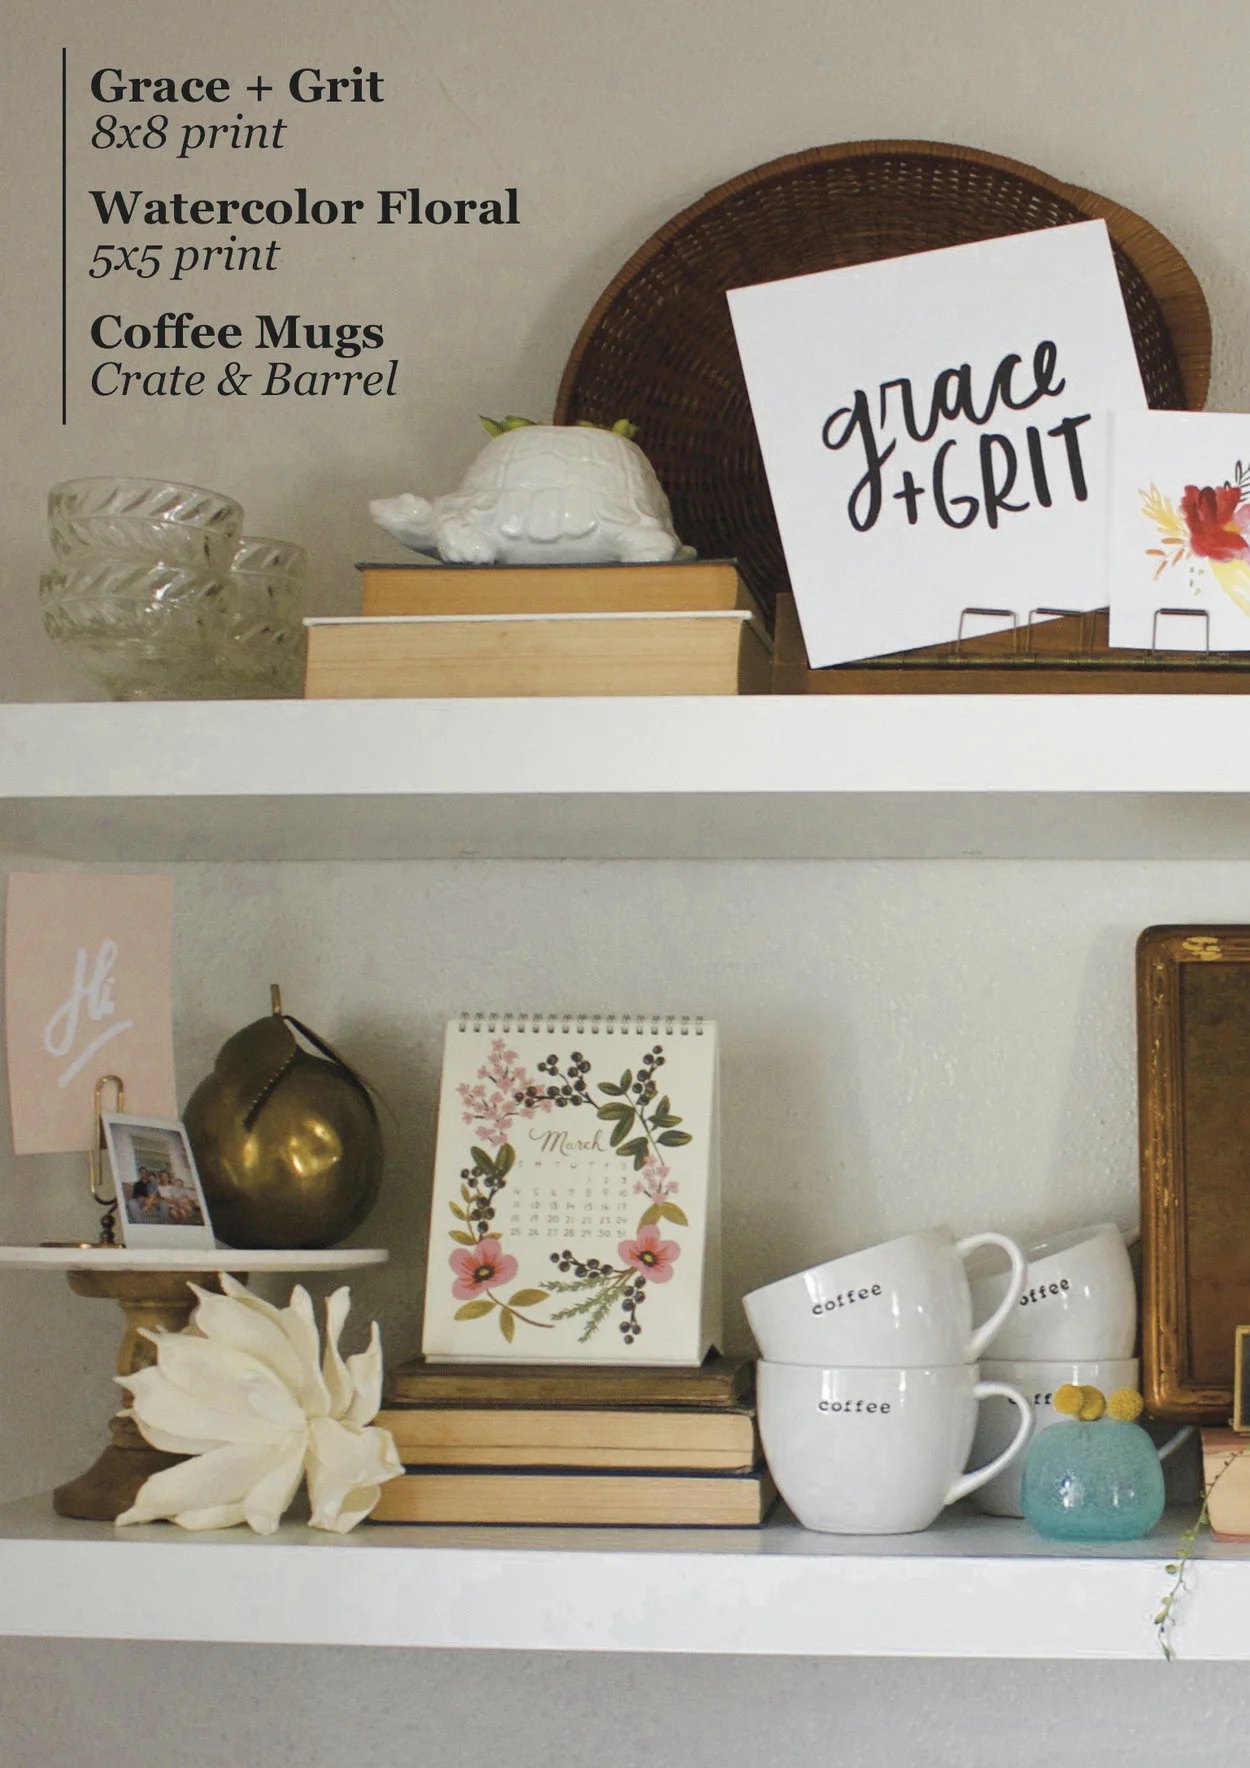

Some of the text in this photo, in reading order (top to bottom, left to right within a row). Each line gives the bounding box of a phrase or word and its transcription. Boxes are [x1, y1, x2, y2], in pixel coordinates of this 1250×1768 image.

[821, 340, 1066, 533] grace
[44, 939, 119, 1057] Hi
[528, 1127, 608, 1157] March
[510, 1228, 626, 1238] 25 26 27 28 29 30 31
[811, 1284, 882, 1315] coffee
[1019, 1279, 1070, 1306] offee
[818, 1400, 891, 1414] coffee
